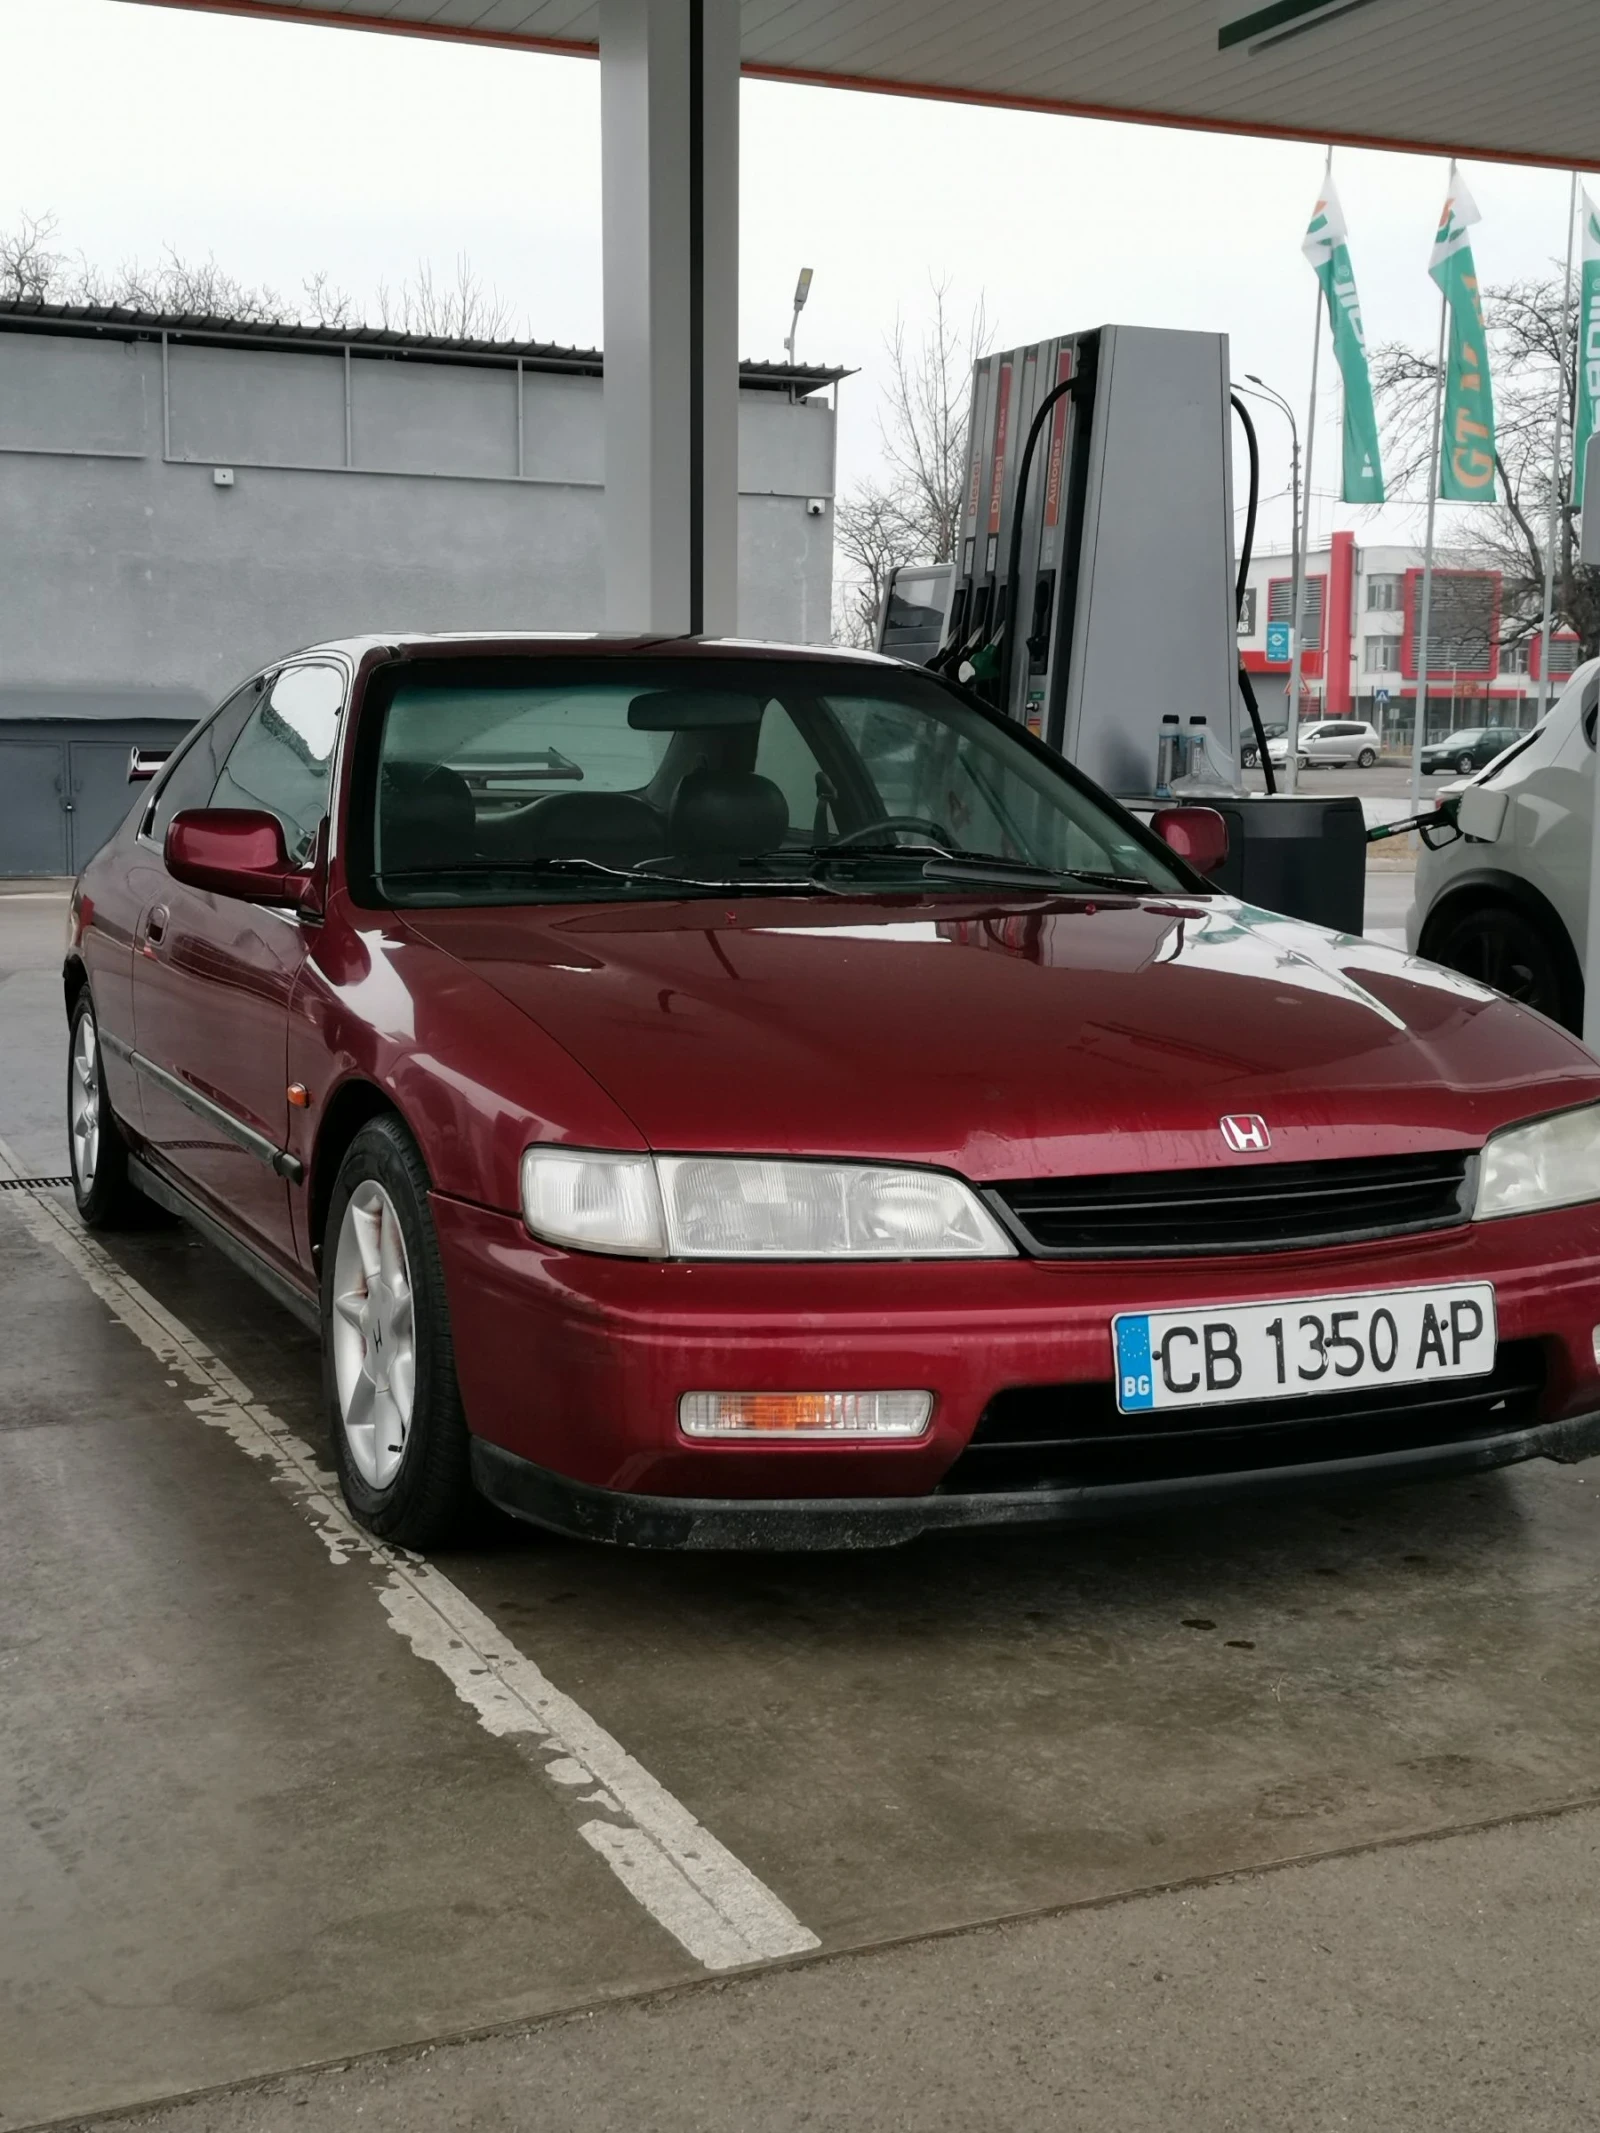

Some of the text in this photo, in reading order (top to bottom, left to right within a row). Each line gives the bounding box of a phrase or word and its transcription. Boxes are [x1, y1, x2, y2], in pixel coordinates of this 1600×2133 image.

[967, 460, 981, 517] Diesel
[990, 455, 1004, 514] Diesel
[1047, 438, 1062, 505] Autogas
[1161, 1299, 1483, 1394] CB 1350 AP
[1121, 1375, 1150, 1398] BG
